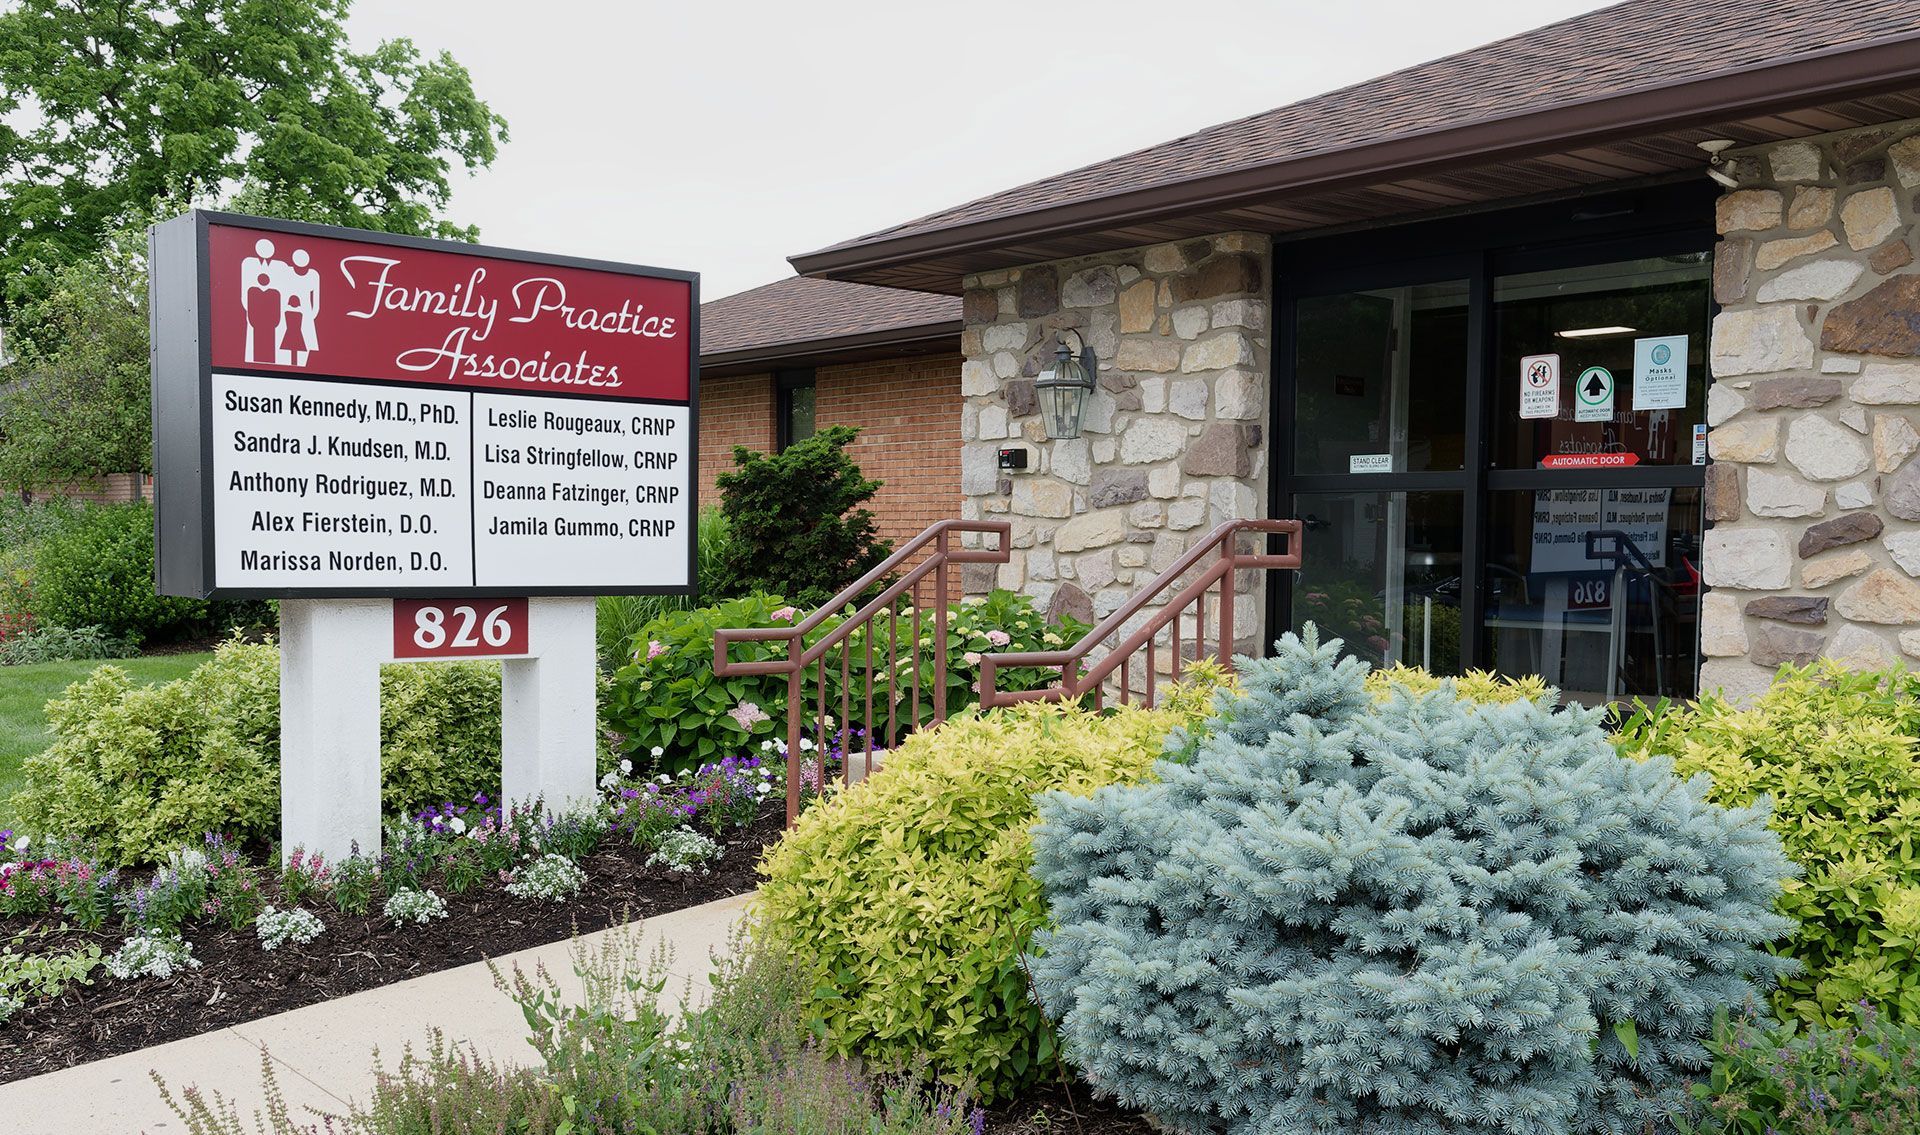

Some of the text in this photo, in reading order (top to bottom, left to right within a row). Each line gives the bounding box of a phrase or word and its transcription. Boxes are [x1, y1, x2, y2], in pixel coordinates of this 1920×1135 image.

[340, 256, 677, 341] Family Practice
[396, 326, 623, 387] Associates
[1645, 374, 1676, 382] Optional
[226, 390, 459, 425] Susan Kennedy, M.D., PhD.
[488, 408, 676, 436] Leslie Rougeaux, CRNP
[234, 431, 450, 462] Sandra J. Knudsen, M.D.
[485, 444, 678, 471] Lisa Stringfellow, CRNP
[1353, 457, 1371, 465] STAND
[1551, 456, 1625, 466] AUTOMATIC DOOR
[230, 471, 456, 500] Anthony Rodriguez, M.D.
[483, 480, 680, 507] Deanna Fatzinger, CRNP
[251, 511, 438, 536] Alex Fierstein, D.O.
[489, 516, 676, 539] Jamila Gummo, CRNP
[241, 550, 448, 574] Marissa Norden, D.O.
[413, 605, 512, 650] 826
